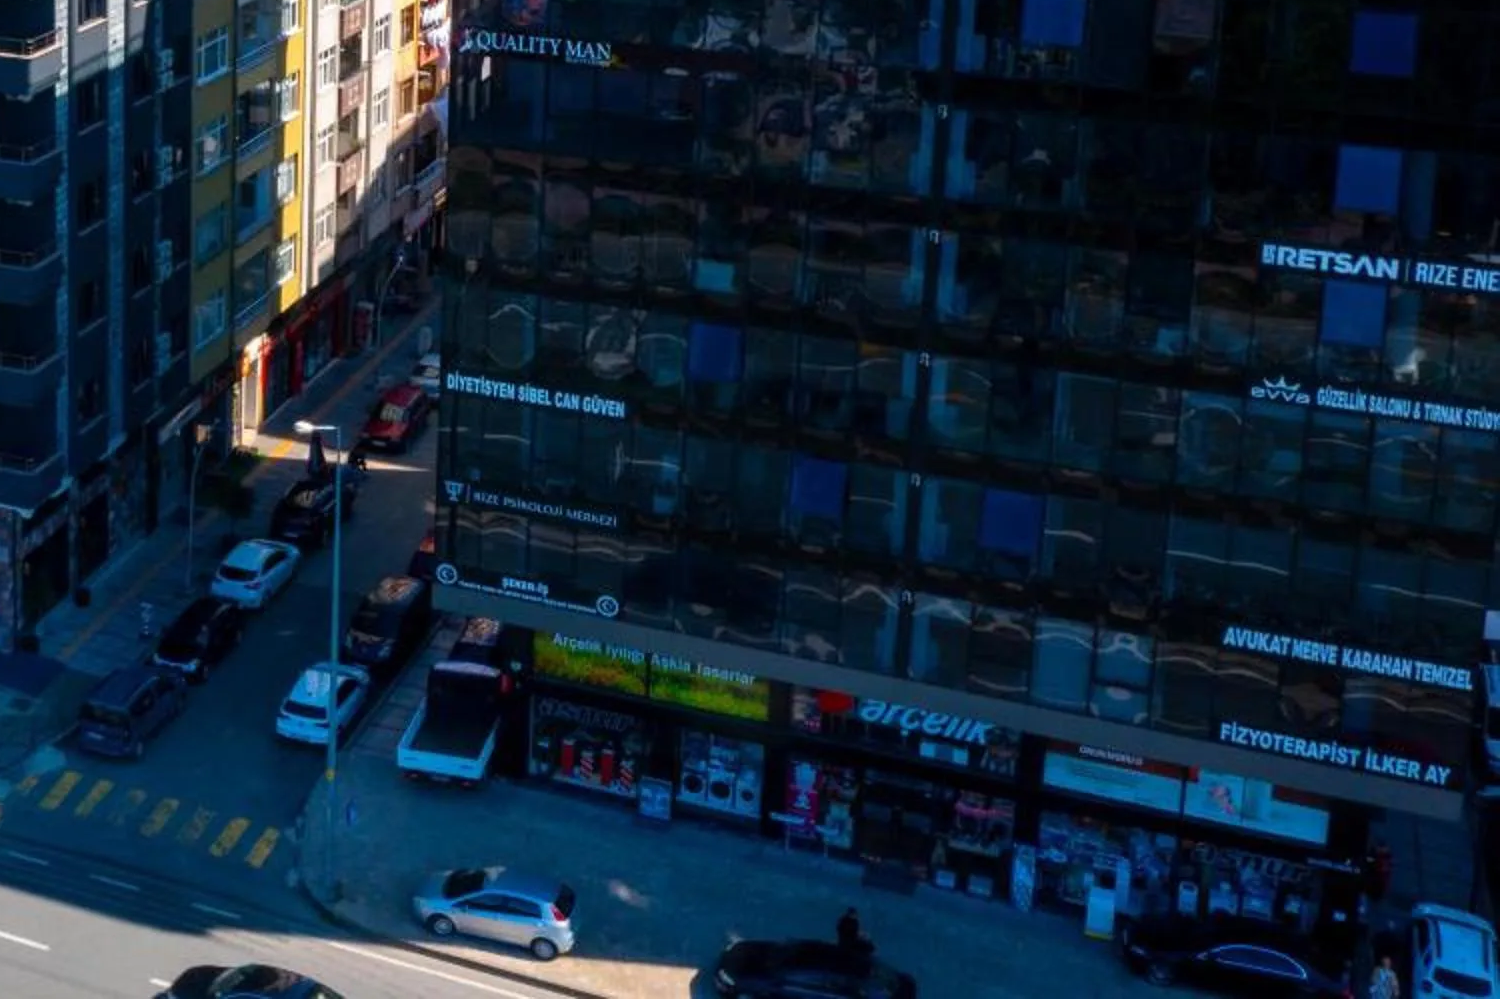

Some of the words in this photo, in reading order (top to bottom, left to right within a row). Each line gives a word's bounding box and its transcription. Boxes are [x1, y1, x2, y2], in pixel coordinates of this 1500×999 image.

[475, 28, 562, 58] QUALITY
[564, 39, 612, 62] MAN
[446, 369, 516, 401] DİYETİSYEN
[517, 382, 553, 407] SİBEL
[553, 390, 581, 412] CAN
[581, 393, 626, 420] GÜVEN
[1368, 395, 1412, 419] SALONU
[1223, 625, 1290, 657] AVUKAT
[1290, 638, 1339, 667] MERVE
[1340, 646, 1412, 679] KARAHAN
[1219, 721, 1362, 769] FİZYOTERAPİST
[1363, 745, 1422, 780] İLKER
[1424, 761, 1453, 786] AY
